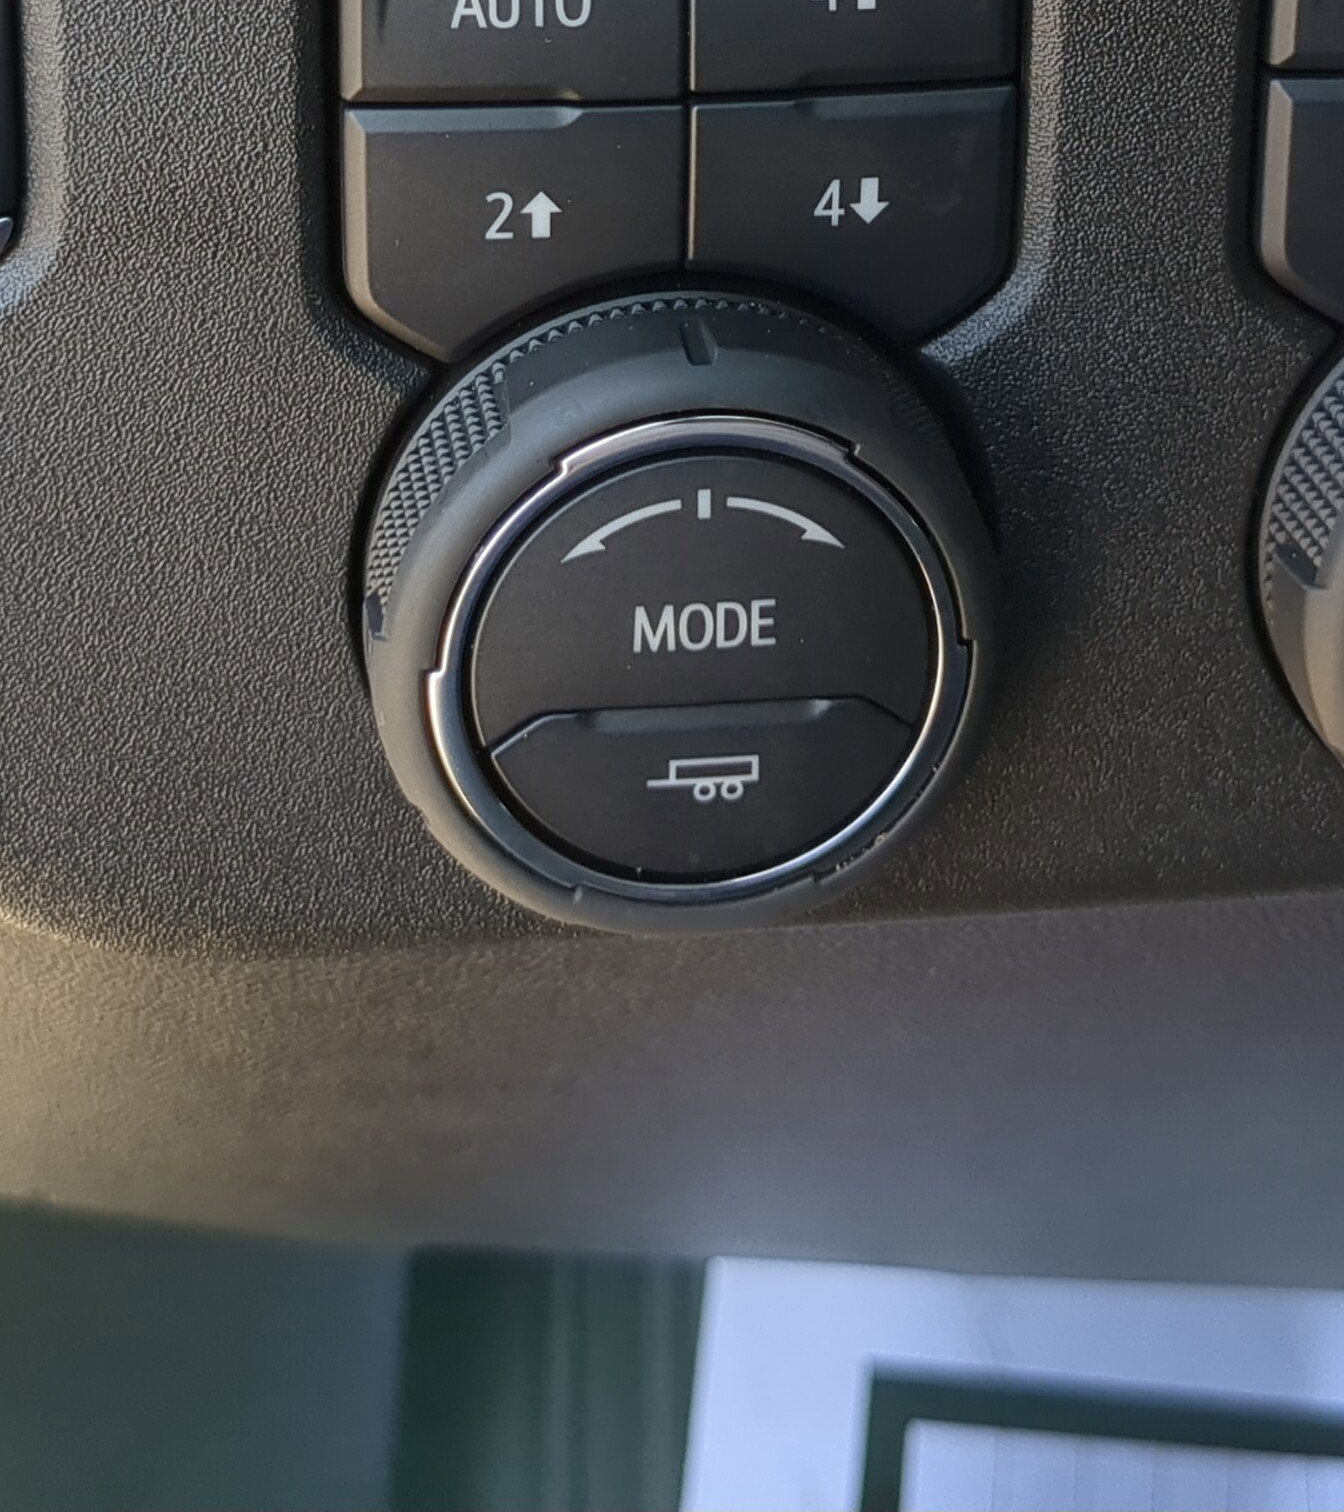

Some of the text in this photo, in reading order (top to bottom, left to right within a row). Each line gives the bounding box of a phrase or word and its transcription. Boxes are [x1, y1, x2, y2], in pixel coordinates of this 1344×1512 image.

[485, 192, 514, 240] 2
[813, 179, 845, 226] 4
[633, 598, 776, 653] MODE
